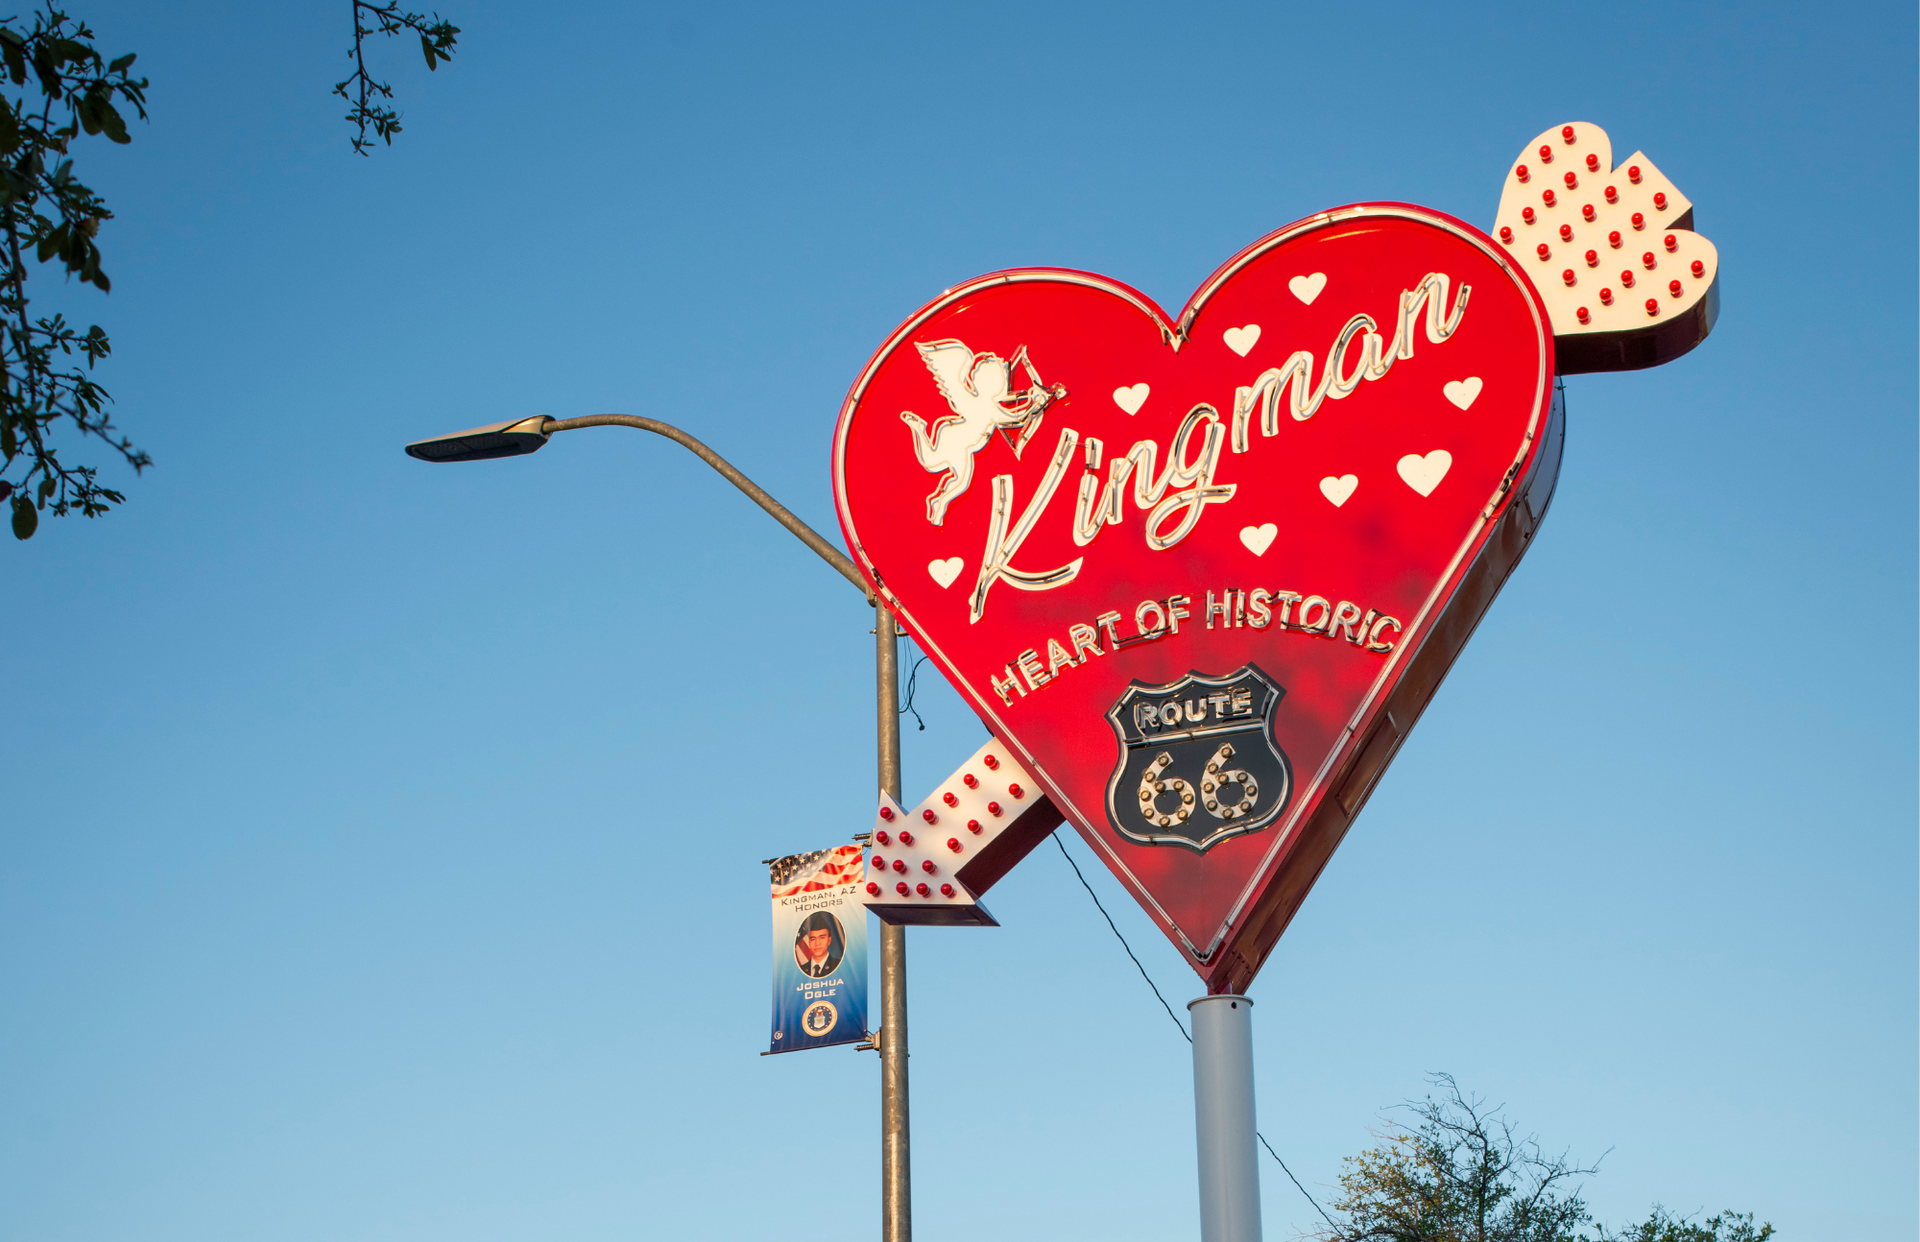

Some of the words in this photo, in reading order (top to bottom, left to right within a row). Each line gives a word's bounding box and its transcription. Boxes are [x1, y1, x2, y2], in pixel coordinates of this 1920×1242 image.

[969, 272, 1472, 624] Kingman
[990, 609, 1121, 708] HEART
[1135, 594, 1190, 640] OF
[1206, 588, 1402, 654] HISTORIC
[1133, 687, 1254, 734] ROUTE
[1138, 743, 1260, 829] 66
[795, 898, 843, 912] HONORS
[841, 885, 856, 895] AZ
[796, 977, 844, 991] JOSHUA
[804, 990, 836, 1000] OGLE
